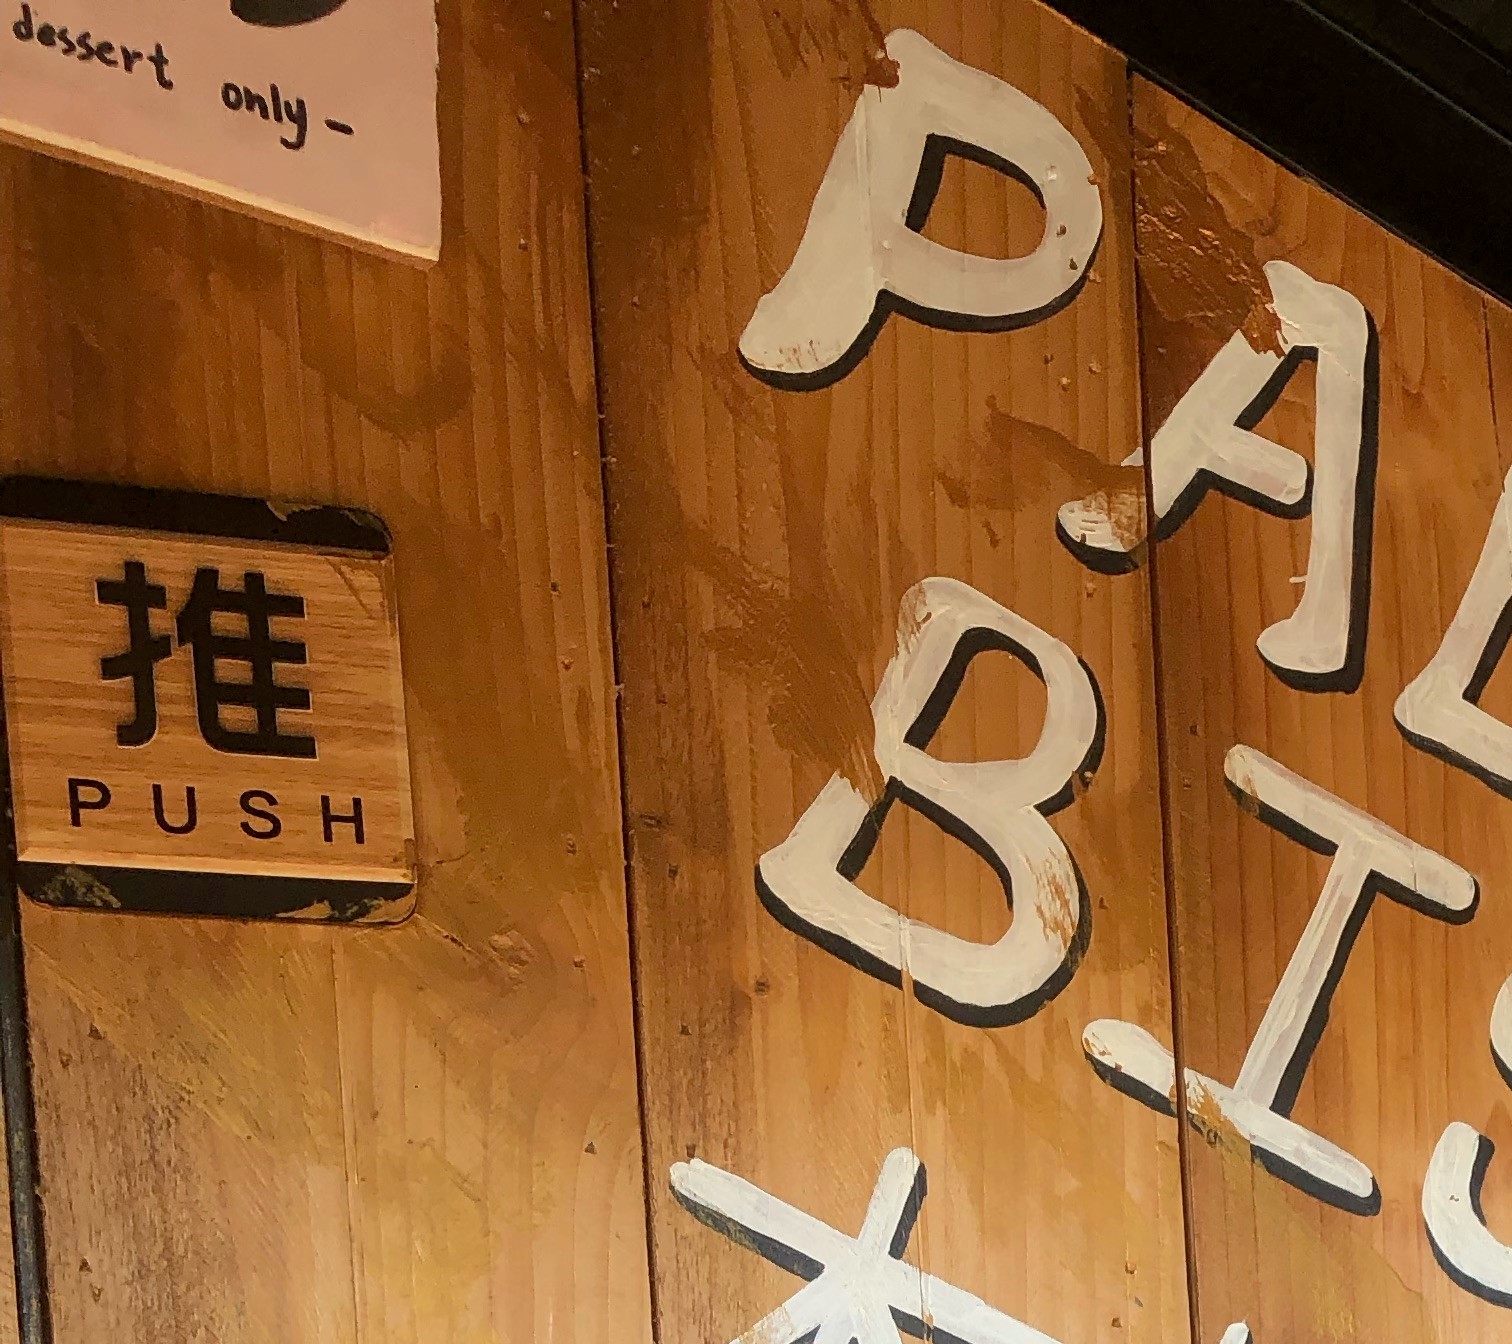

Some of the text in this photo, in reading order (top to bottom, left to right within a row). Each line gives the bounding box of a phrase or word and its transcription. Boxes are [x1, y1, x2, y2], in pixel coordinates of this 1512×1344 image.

[12, 2, 174, 90] dessert
[96, 562, 318, 760] 推
[68, 778, 366, 846] PUSH
